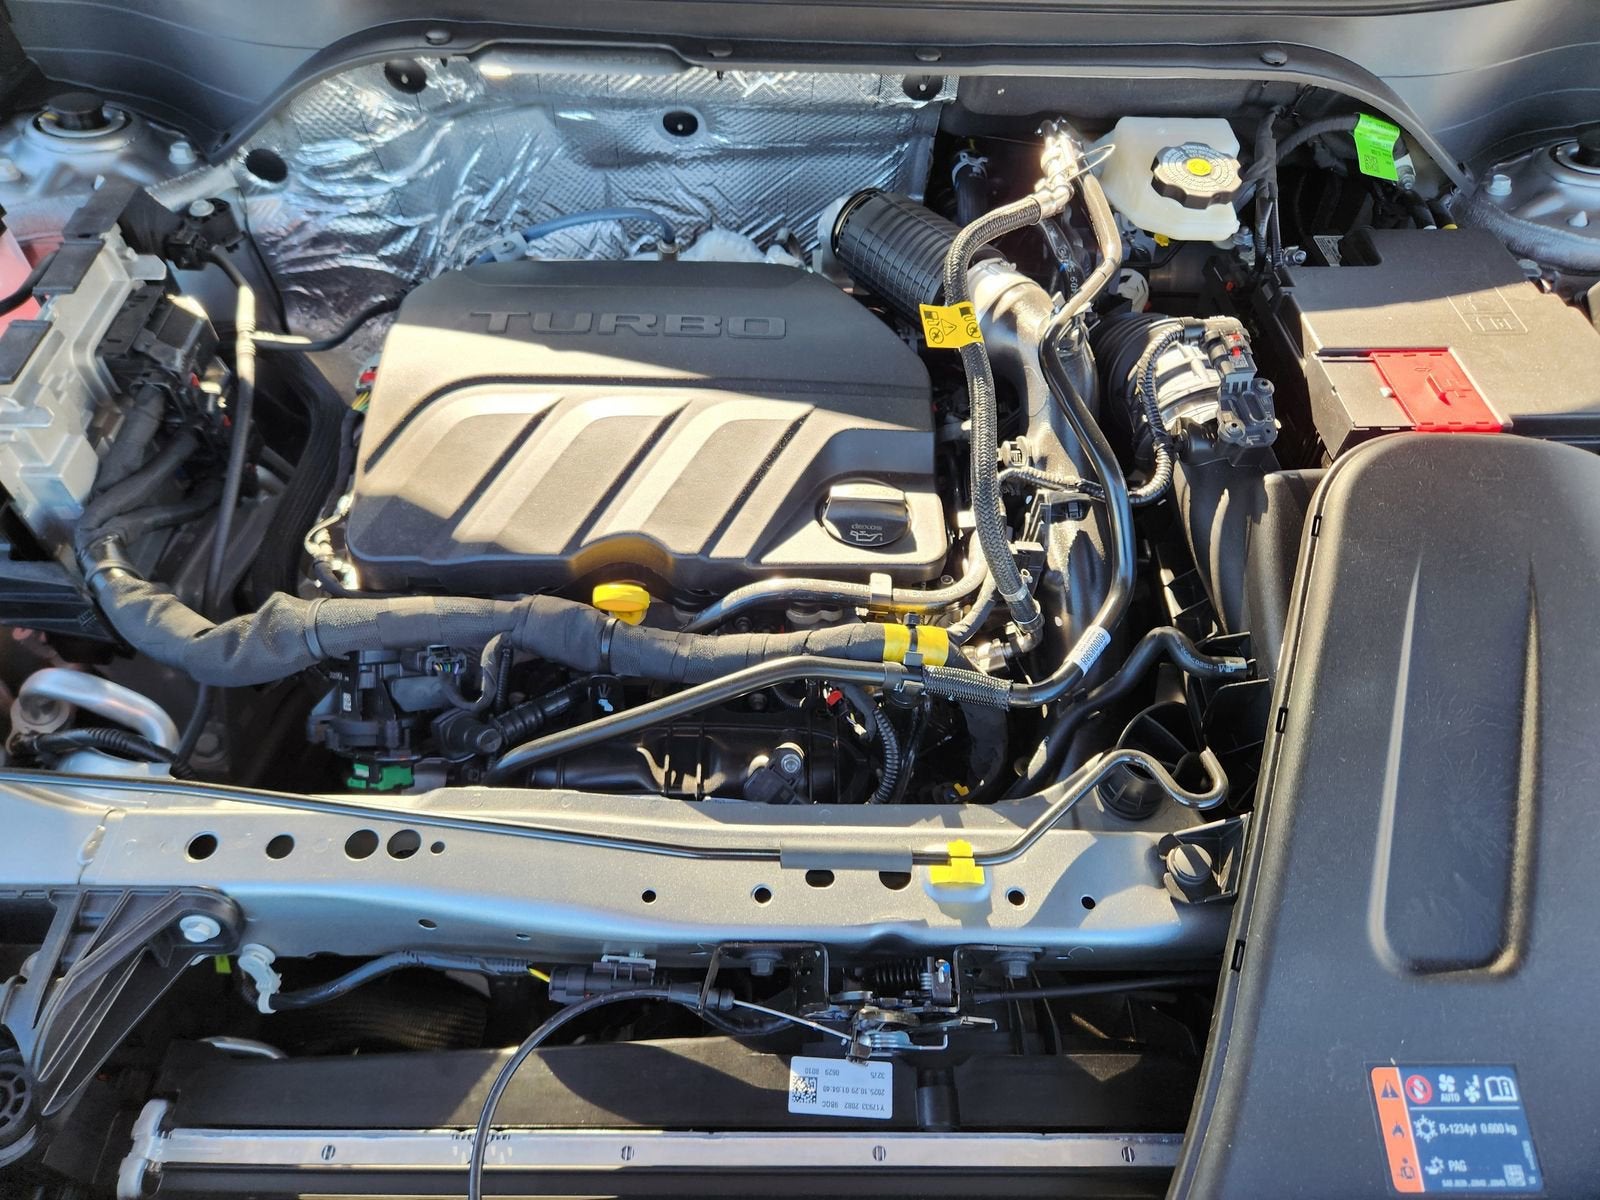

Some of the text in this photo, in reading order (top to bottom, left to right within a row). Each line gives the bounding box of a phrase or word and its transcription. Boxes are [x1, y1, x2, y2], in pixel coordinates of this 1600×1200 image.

[470, 311, 787, 340] TURBO
[1441, 1093, 1460, 1102] AUTO
[1438, 1122, 1477, 1137] R-1234yf
[1504, 1122, 1518, 1136] kg
[1448, 1159, 1467, 1172] PAG
